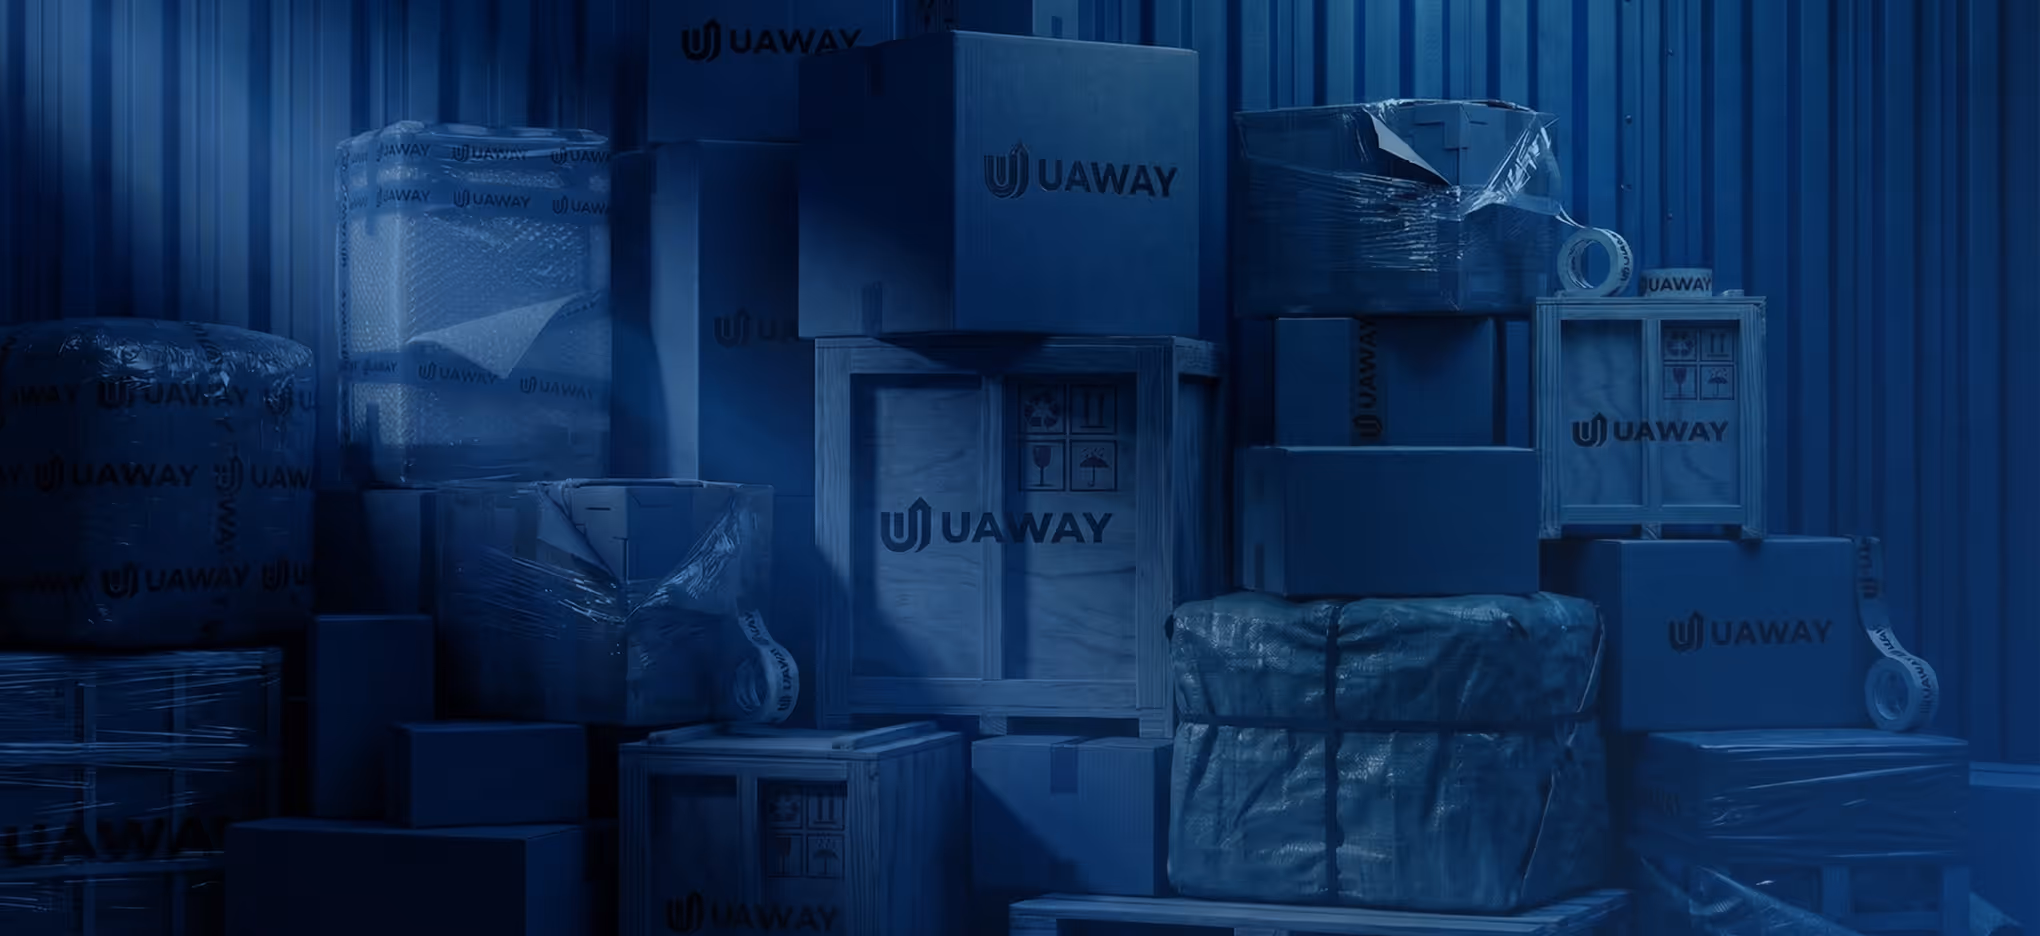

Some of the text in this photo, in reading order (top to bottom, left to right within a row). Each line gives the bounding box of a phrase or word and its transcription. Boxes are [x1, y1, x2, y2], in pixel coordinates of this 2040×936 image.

[729, 28, 863, 55] UAWAY
[1038, 159, 1178, 198] UAWAY
[473, 193, 530, 209] UAWAY
[1649, 276, 1712, 293] UAWAY
[440, 366, 498, 385] UAWAY
[1613, 420, 1728, 441] UAWAY
[72, 463, 198, 487] UAWAY
[942, 511, 1113, 543] UAWAY
[146, 563, 249, 592] UAWAY
[1711, 618, 1833, 645] UAWAY
[711, 901, 838, 931] UAWAY
